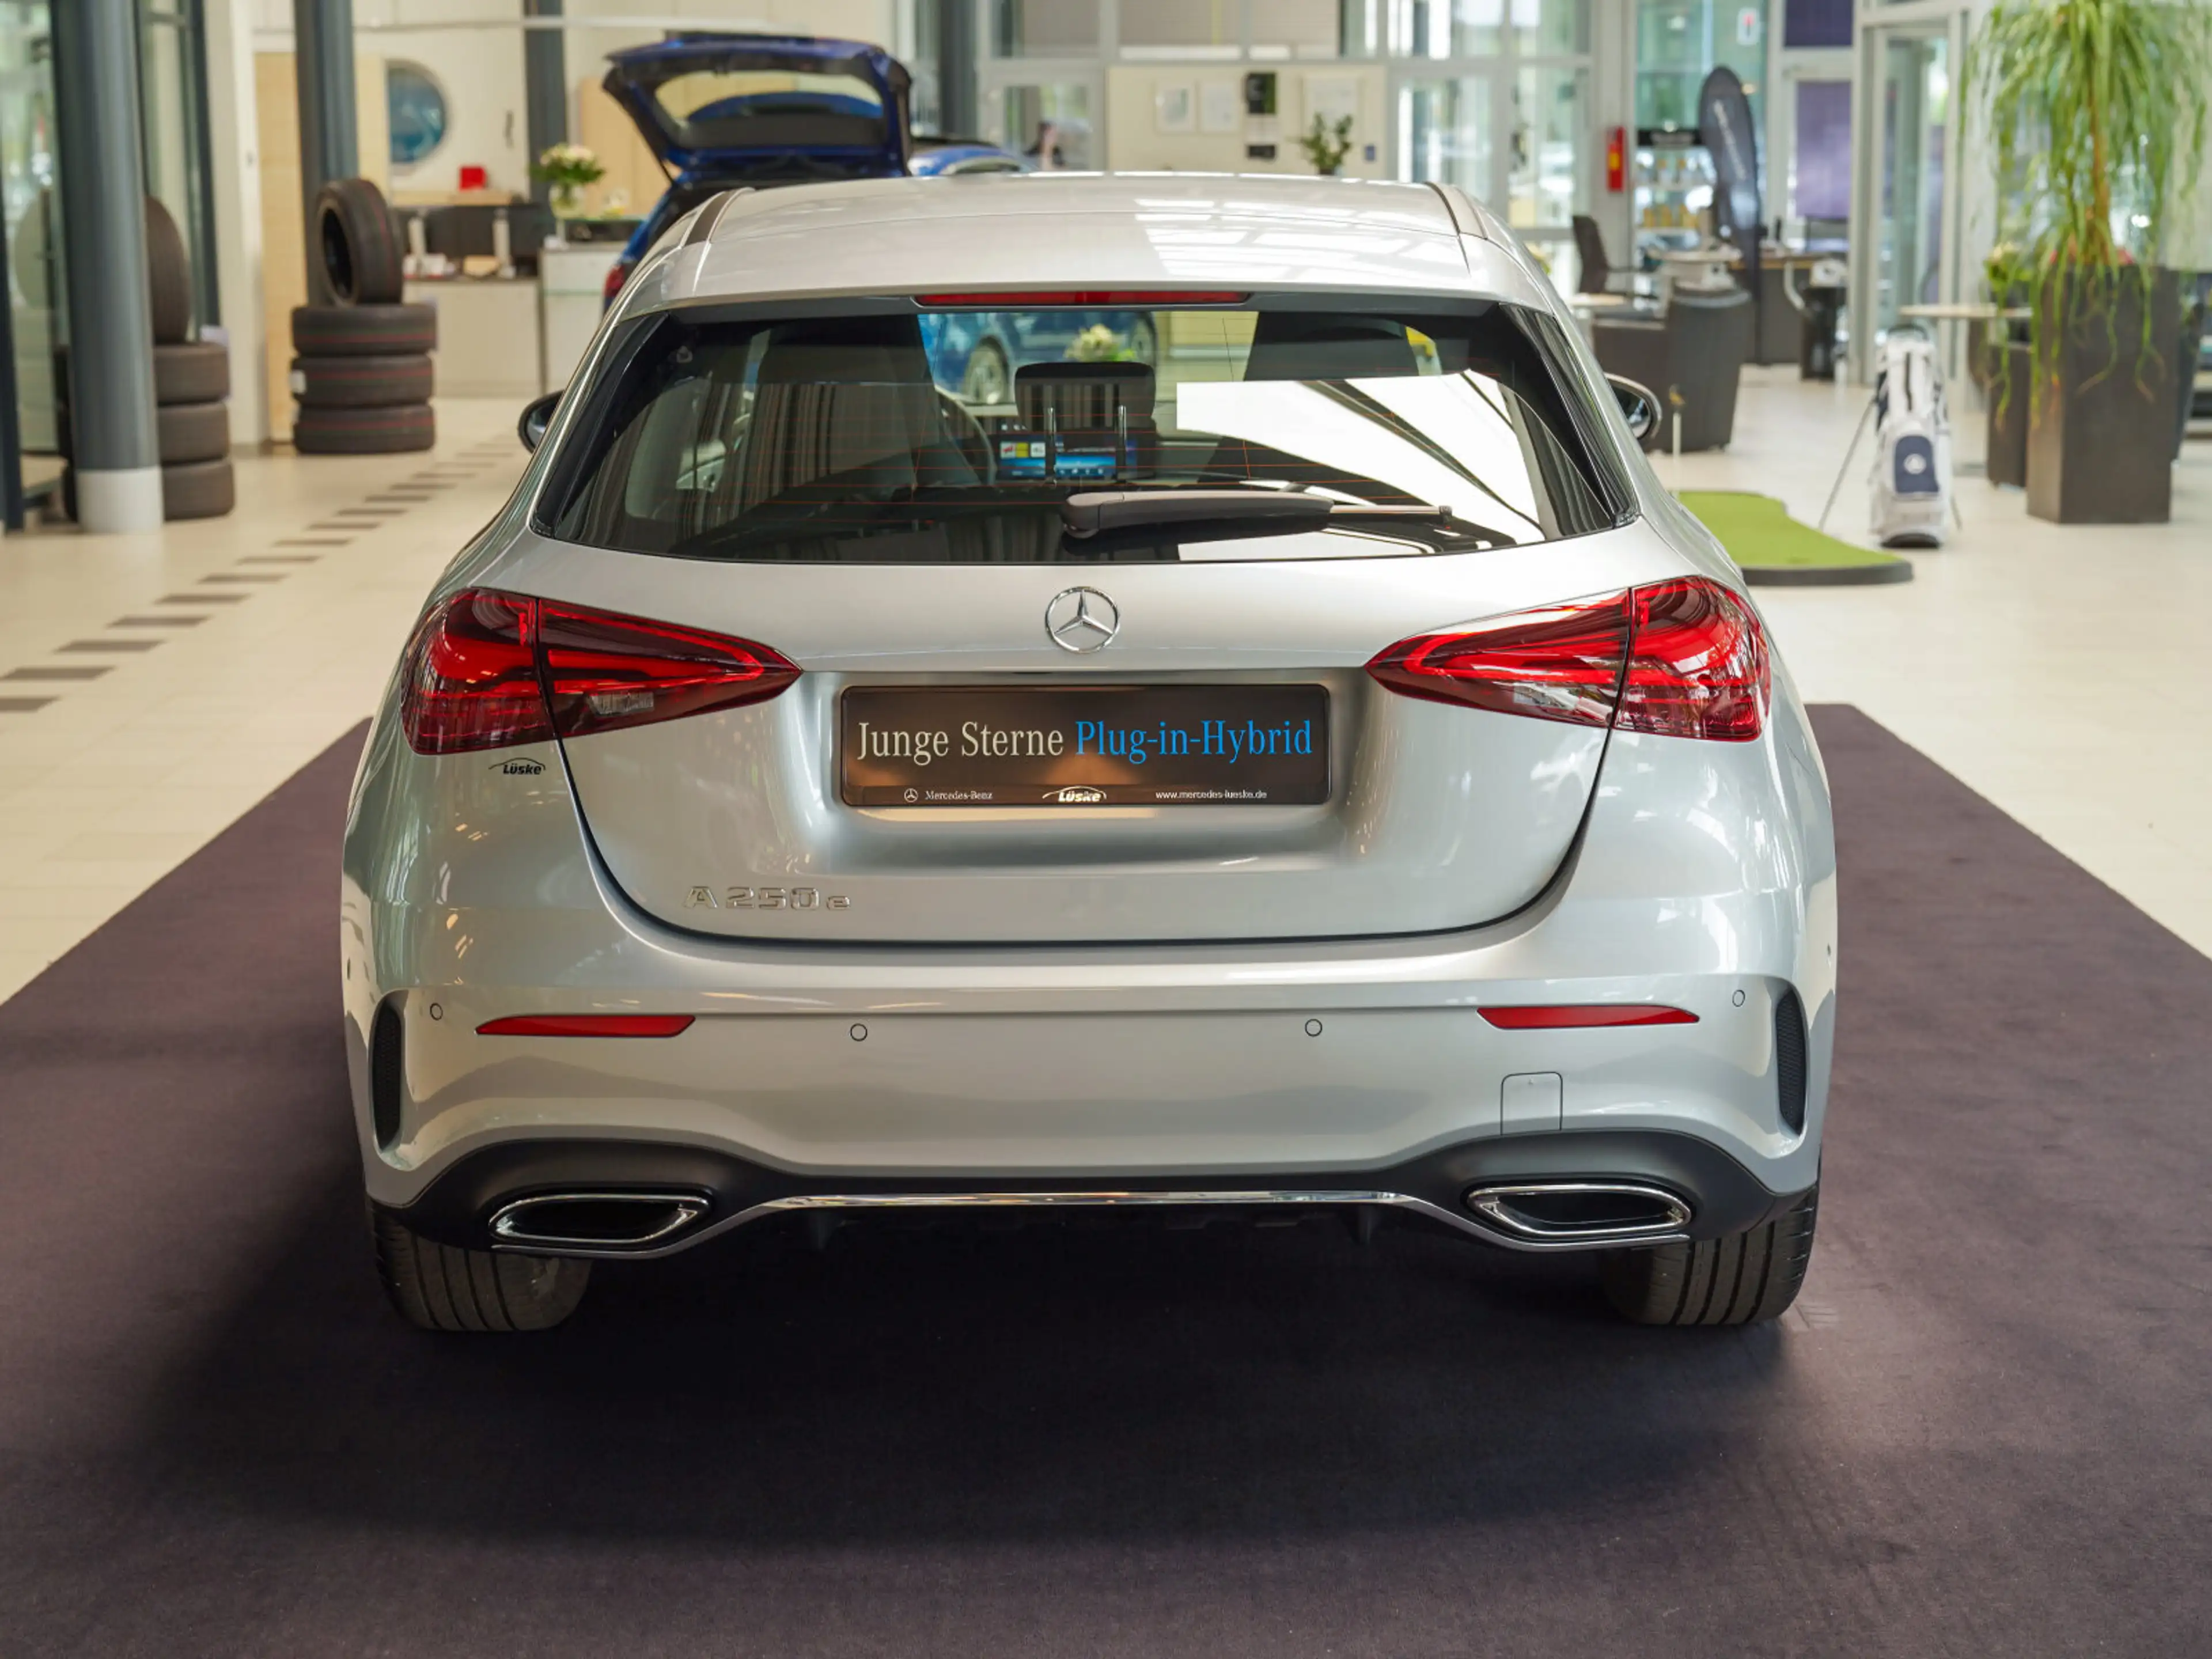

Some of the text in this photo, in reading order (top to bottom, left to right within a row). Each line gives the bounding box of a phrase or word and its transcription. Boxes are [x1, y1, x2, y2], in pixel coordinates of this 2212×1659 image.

[857, 720, 1313, 766] Junge Sterne Plug-in-Hybrid
[503, 763, 542, 775] Lüske
[925, 790, 993, 800] Mercedes-Benz
[1058, 790, 1101, 802] Lüske
[1155, 789, 1267, 799] www.mercedes-lueske.de
[725, 887, 820, 911] 250
